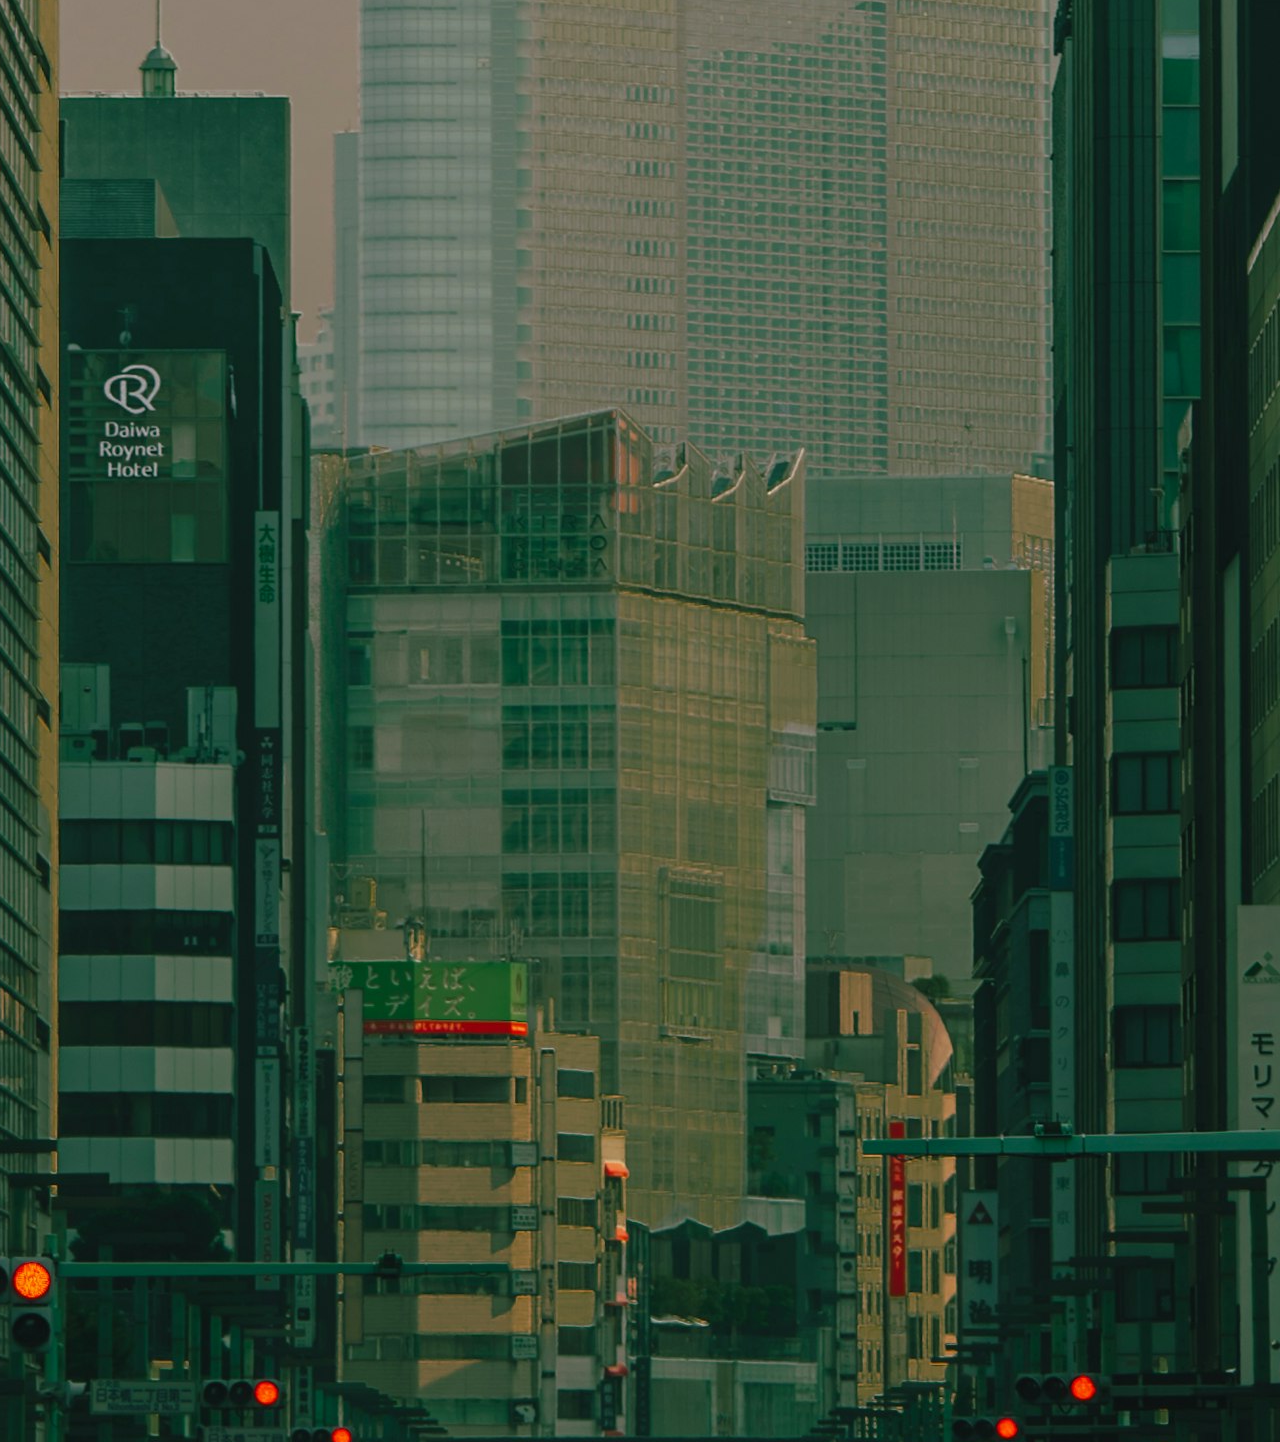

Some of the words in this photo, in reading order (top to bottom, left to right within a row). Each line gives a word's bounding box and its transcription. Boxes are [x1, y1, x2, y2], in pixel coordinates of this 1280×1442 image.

[105, 421, 160, 437] Daiwa
[99, 441, 164, 461] Roynet
[107, 461, 158, 477] Hotel
[259, 524, 274, 604] 大樹生命
[1055, 961, 1071, 1226] 鼻のクリニ東京
[263, 1233, 272, 1282] YUDN
